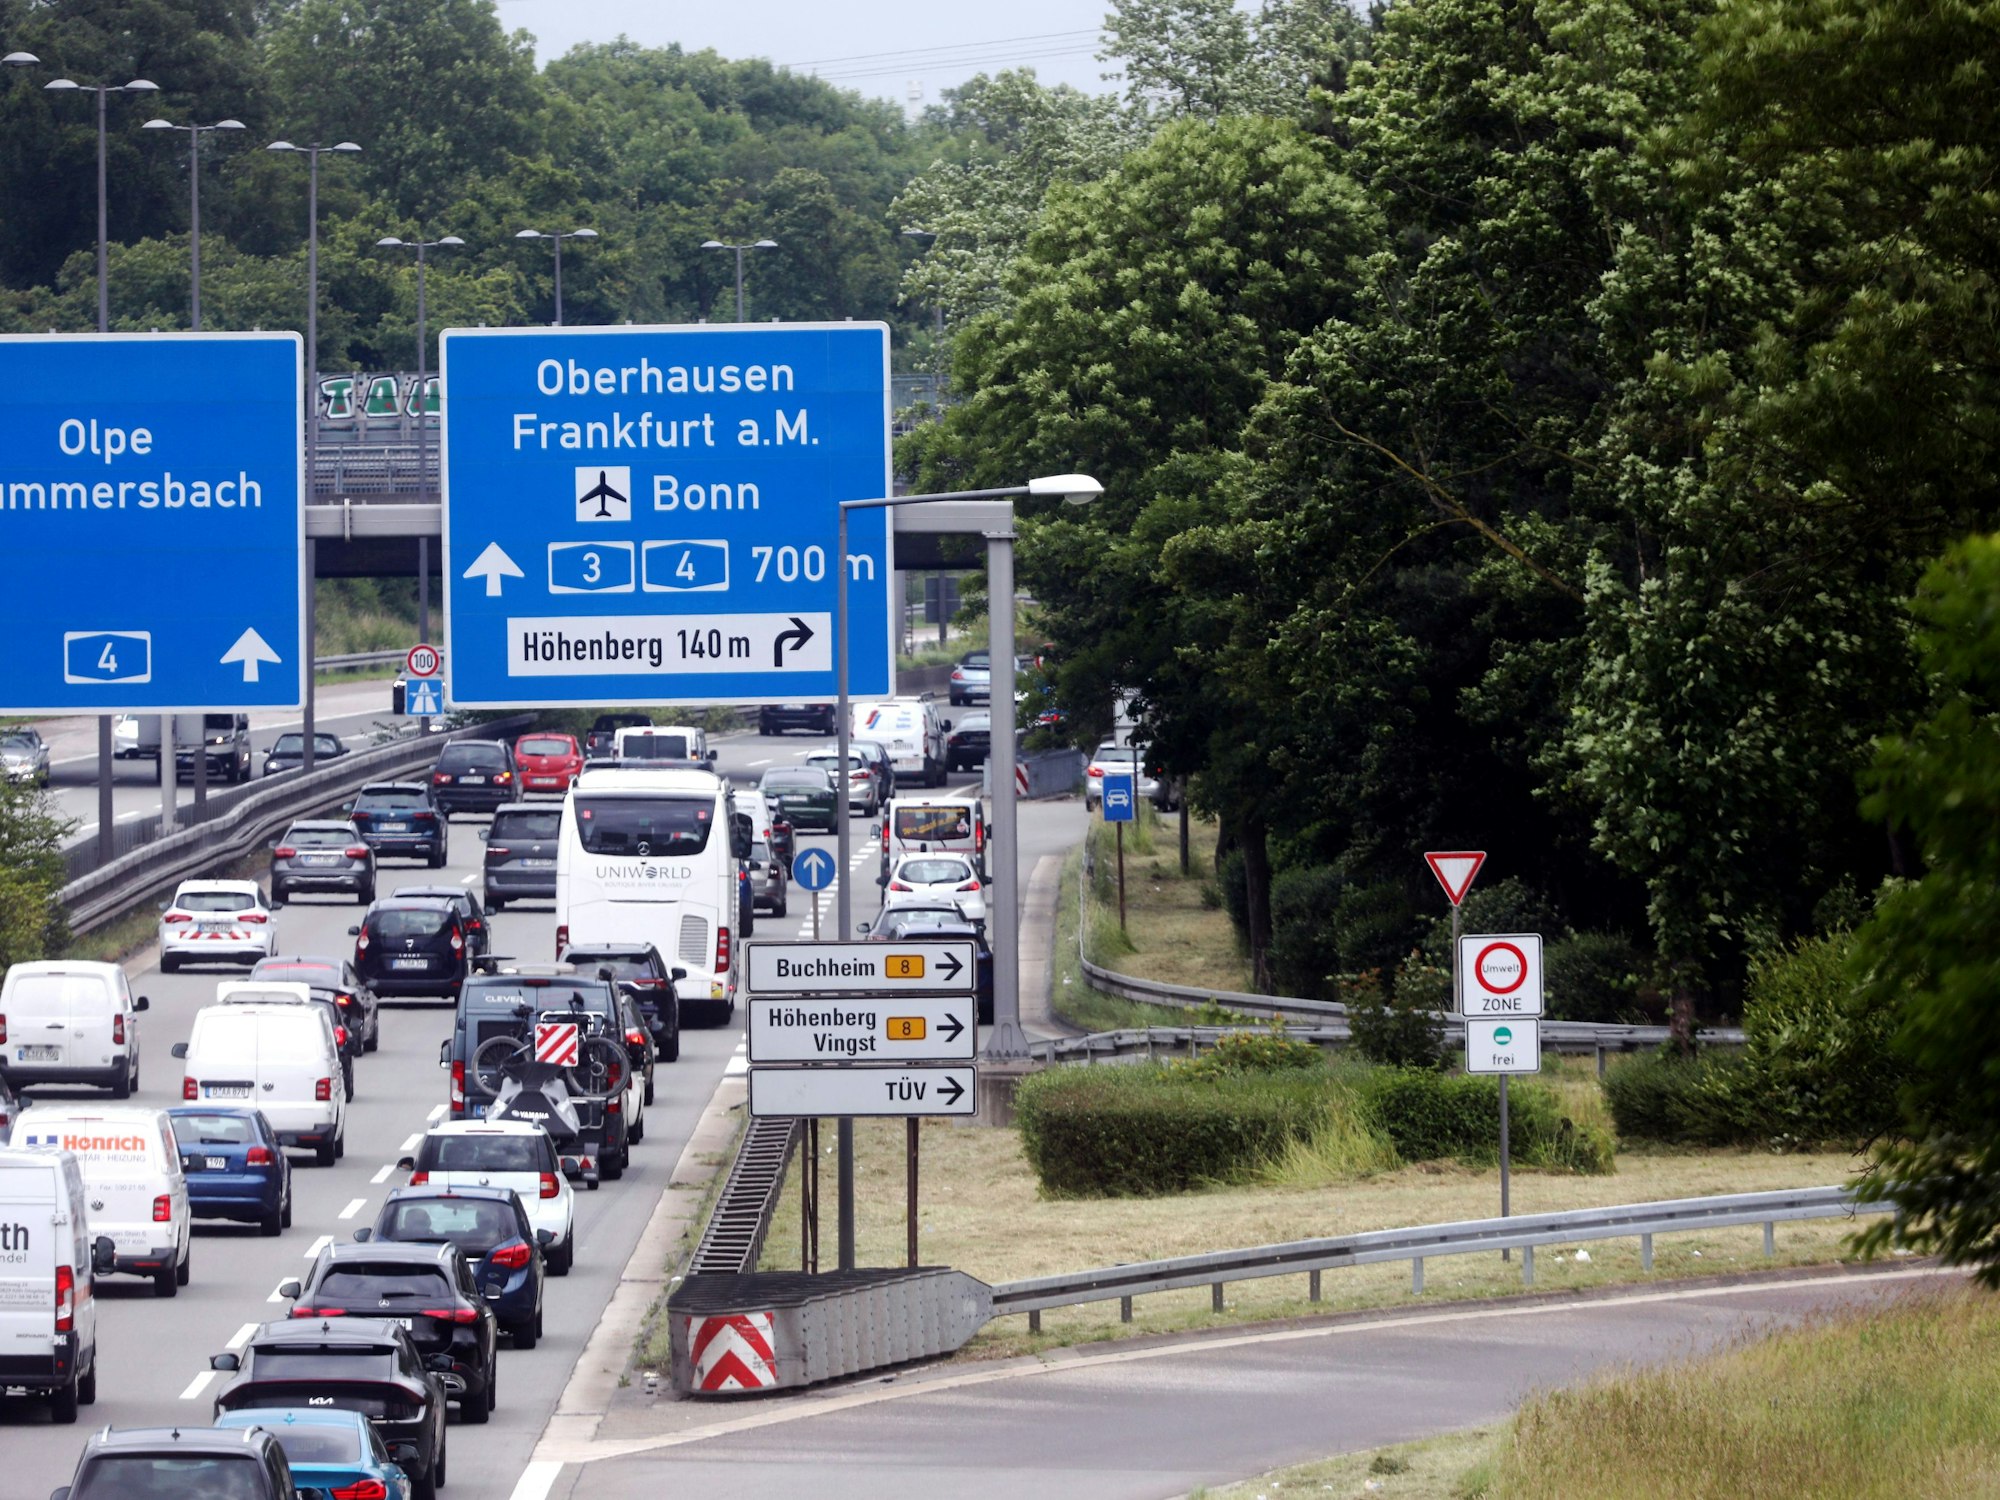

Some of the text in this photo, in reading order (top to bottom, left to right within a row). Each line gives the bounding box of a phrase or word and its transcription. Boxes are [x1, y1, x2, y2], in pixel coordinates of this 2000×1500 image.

[537, 357, 794, 396] Oberhausen
[59, 418, 153, 464] Olpe
[513, 408, 819, 450] Frankfurt a.M.
[0, 471, 261, 509] mmersbach
[653, 475, 760, 511] Bonn
[582, 552, 601, 583] 3
[675, 550, 696, 581] 4
[751, 545, 874, 582] 700 m
[97, 642, 118, 673] 4
[413, 653, 433, 668] 100
[523, 630, 662, 668] Höhenberg
[596, 866, 692, 879] UNIWORLD
[777, 958, 910, 977] Buchheim 8
[1482, 964, 1520, 973] Umwelt
[1482, 998, 1522, 1011] ZONE
[769, 1007, 911, 1036] Höhenberg 8
[813, 1033, 877, 1056] Vingst
[1492, 1053, 1515, 1065] frei
[885, 1076, 927, 1101] TÜV
[520, 1111, 549, 1119] YAMAHA
